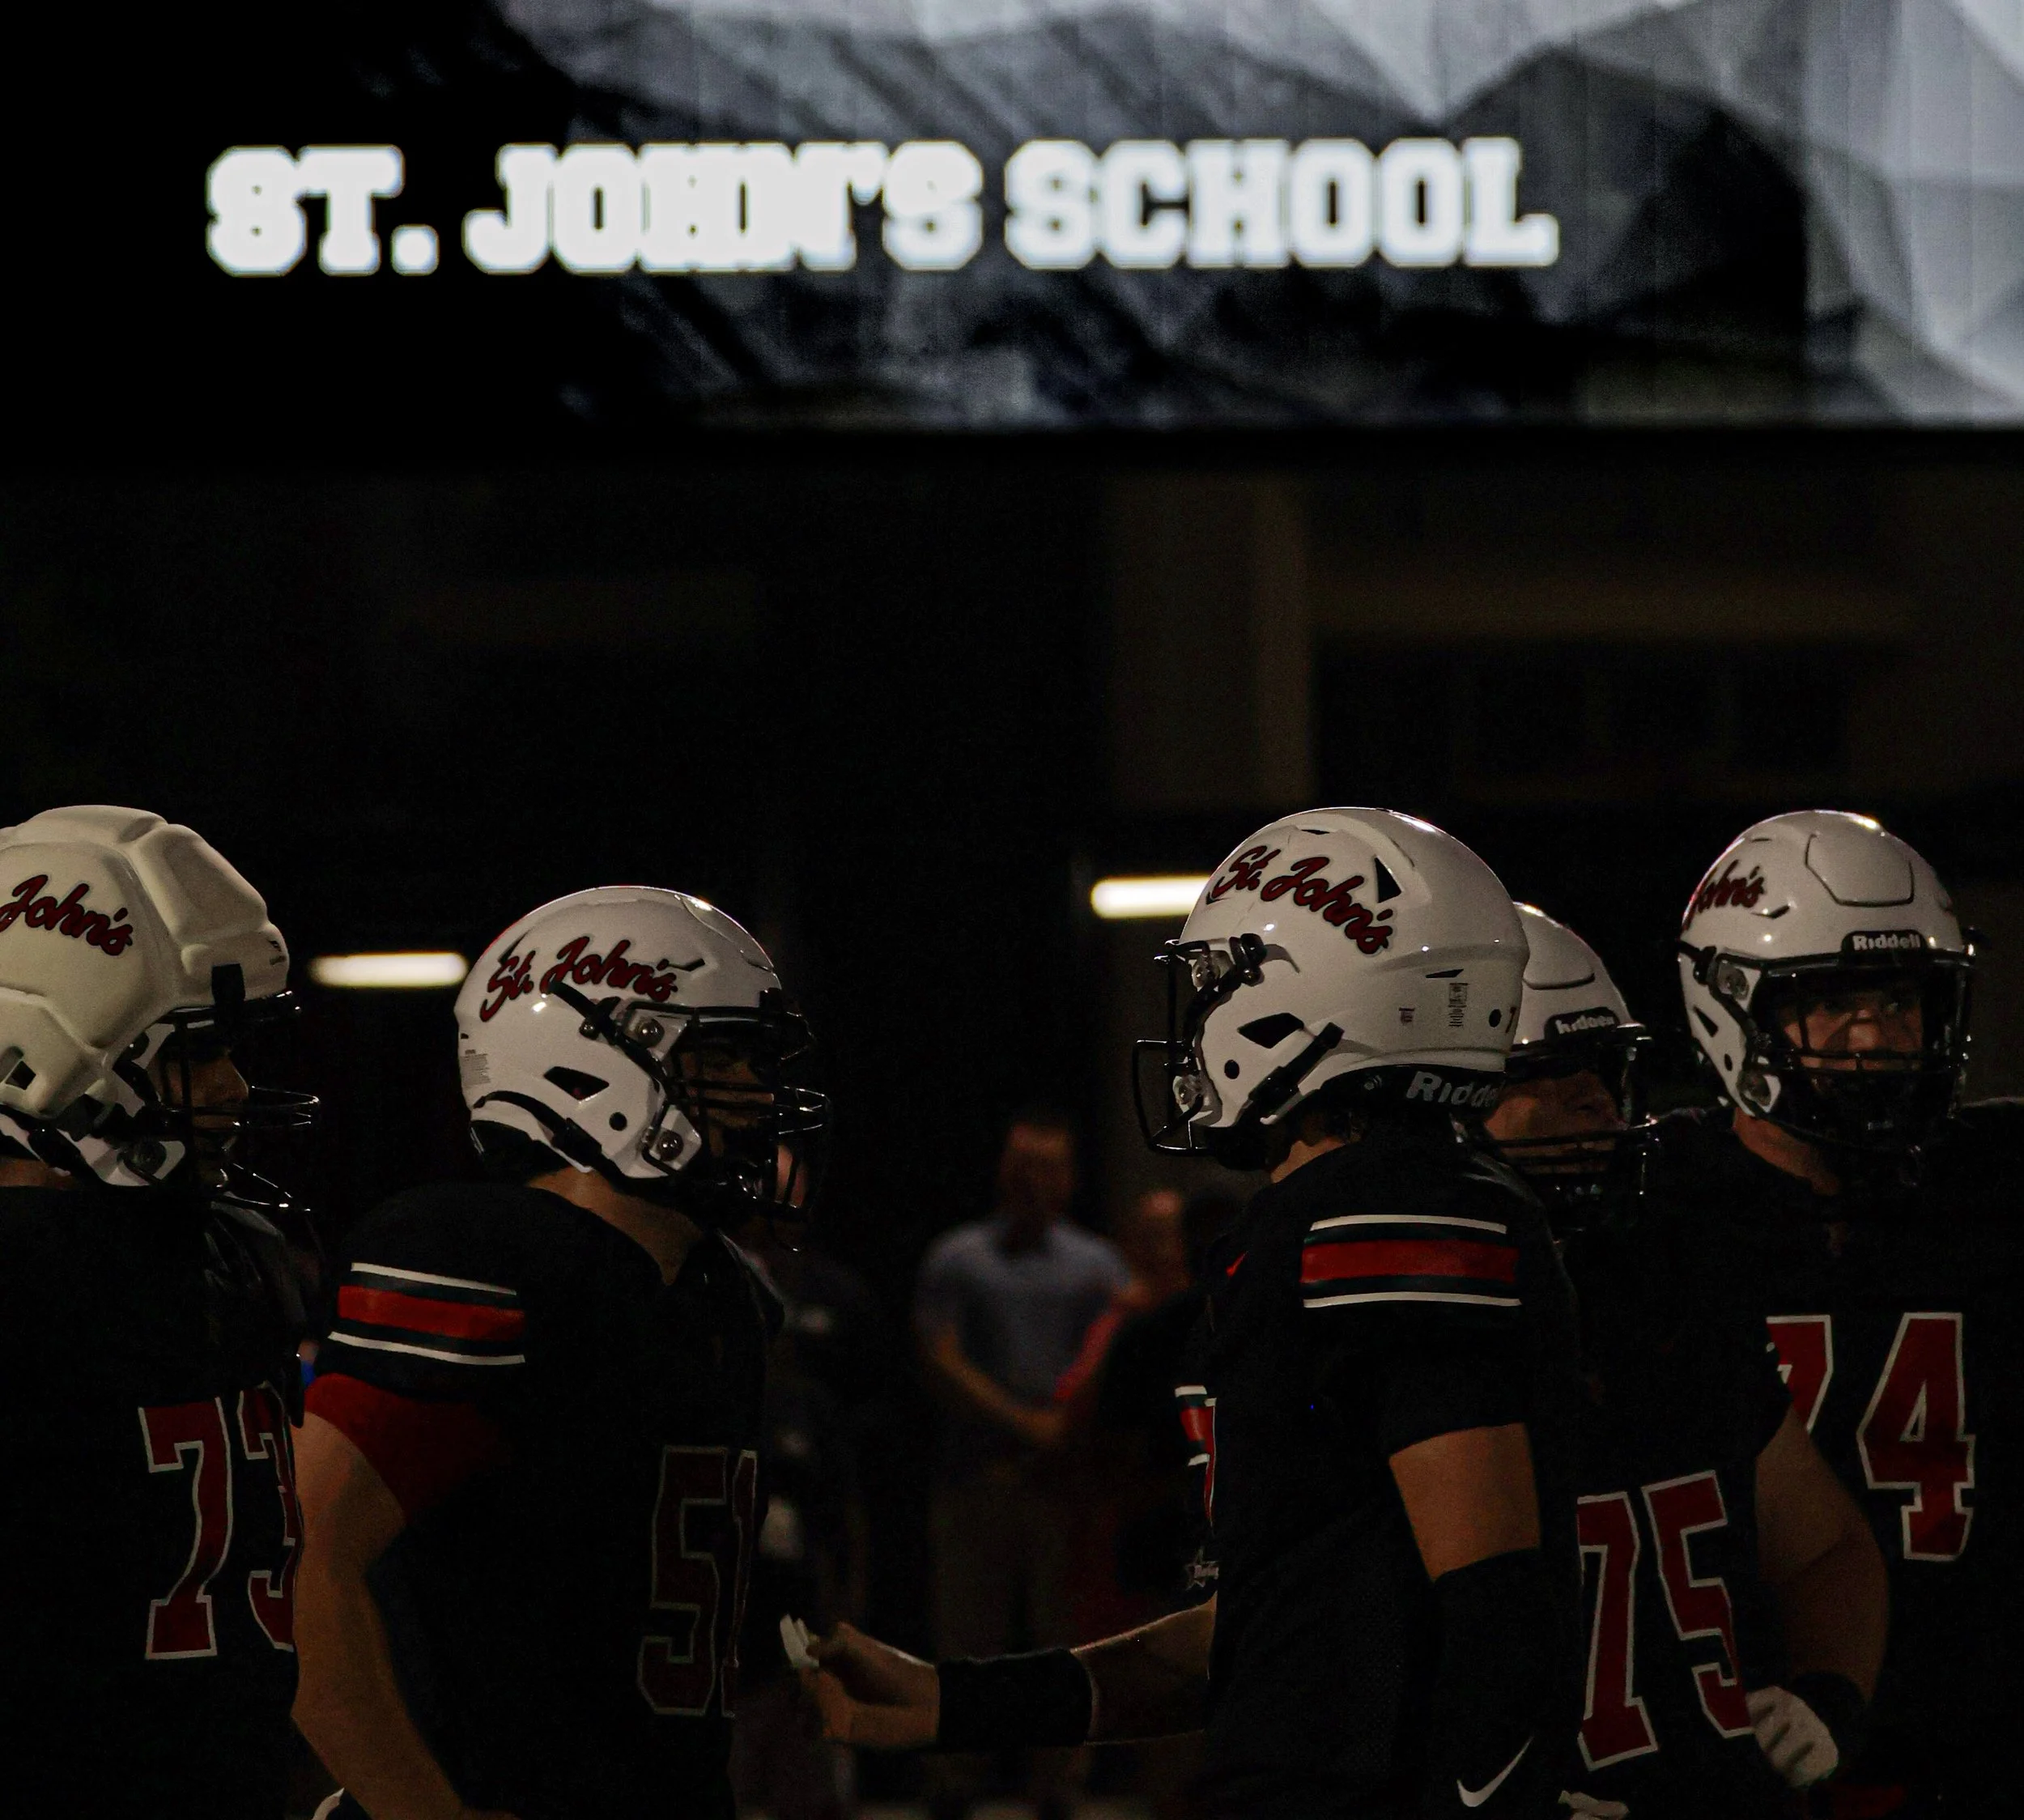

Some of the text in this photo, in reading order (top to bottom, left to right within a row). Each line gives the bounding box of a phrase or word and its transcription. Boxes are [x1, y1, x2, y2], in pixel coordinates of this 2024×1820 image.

[207, 137, 1561, 276] ST. JOHN'S SCHOOL
[1261, 856, 1393, 955] John's
[1852, 933, 1922, 951] Riddell
[539, 935, 678, 1001] John's
[1576, 1469, 1755, 1771] 75
